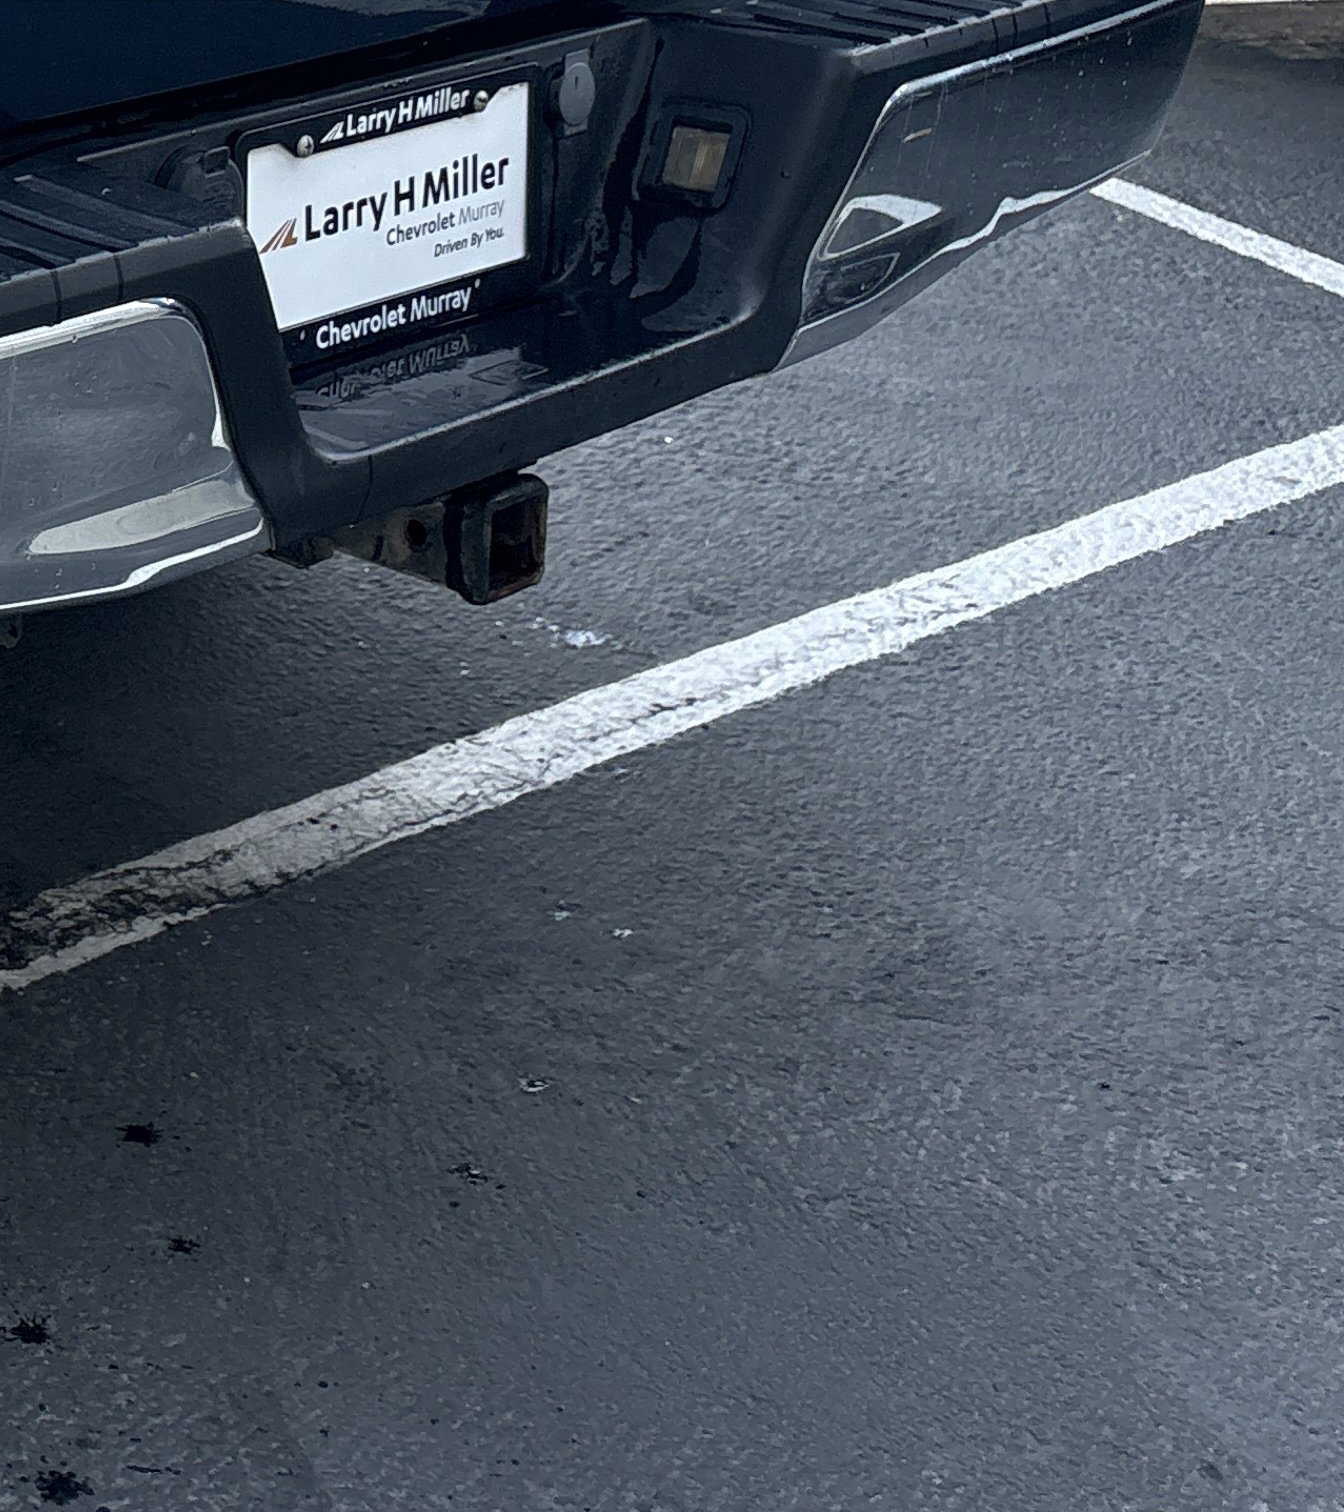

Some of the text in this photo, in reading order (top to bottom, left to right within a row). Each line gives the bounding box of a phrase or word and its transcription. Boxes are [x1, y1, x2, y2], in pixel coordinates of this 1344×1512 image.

[346, 87, 470, 137] Larry H Miller
[305, 153, 509, 242] Larry H Miller
[386, 199, 505, 246] Chevrolet Murray
[434, 238, 467, 257] Driven
[470, 233, 484, 248] By
[315, 287, 472, 349] Chevrolet Murray
